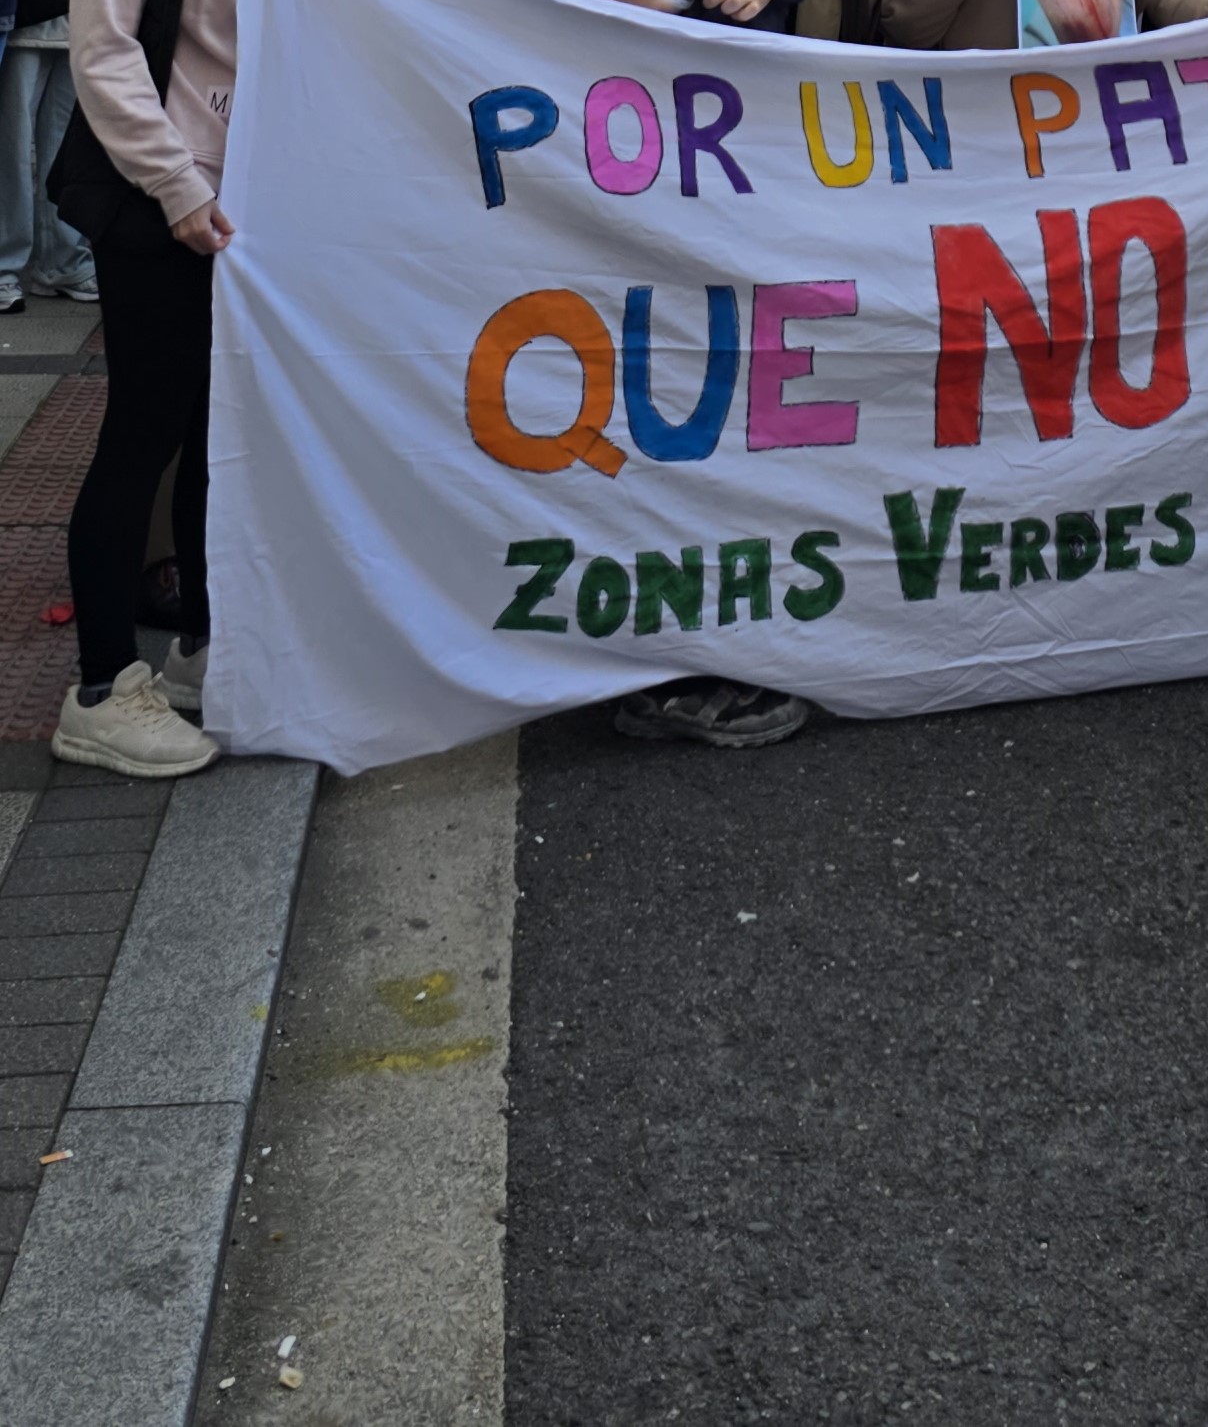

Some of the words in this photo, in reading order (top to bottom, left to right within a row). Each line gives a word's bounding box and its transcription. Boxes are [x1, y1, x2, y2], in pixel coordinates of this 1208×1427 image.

[469, 73, 756, 209] POR
[800, 77, 953, 188] UN
[465, 279, 860, 479] QUE
[930, 195, 1192, 449] NO
[492, 529, 847, 639] ZONAS
[883, 486, 1197, 602] VERDES
